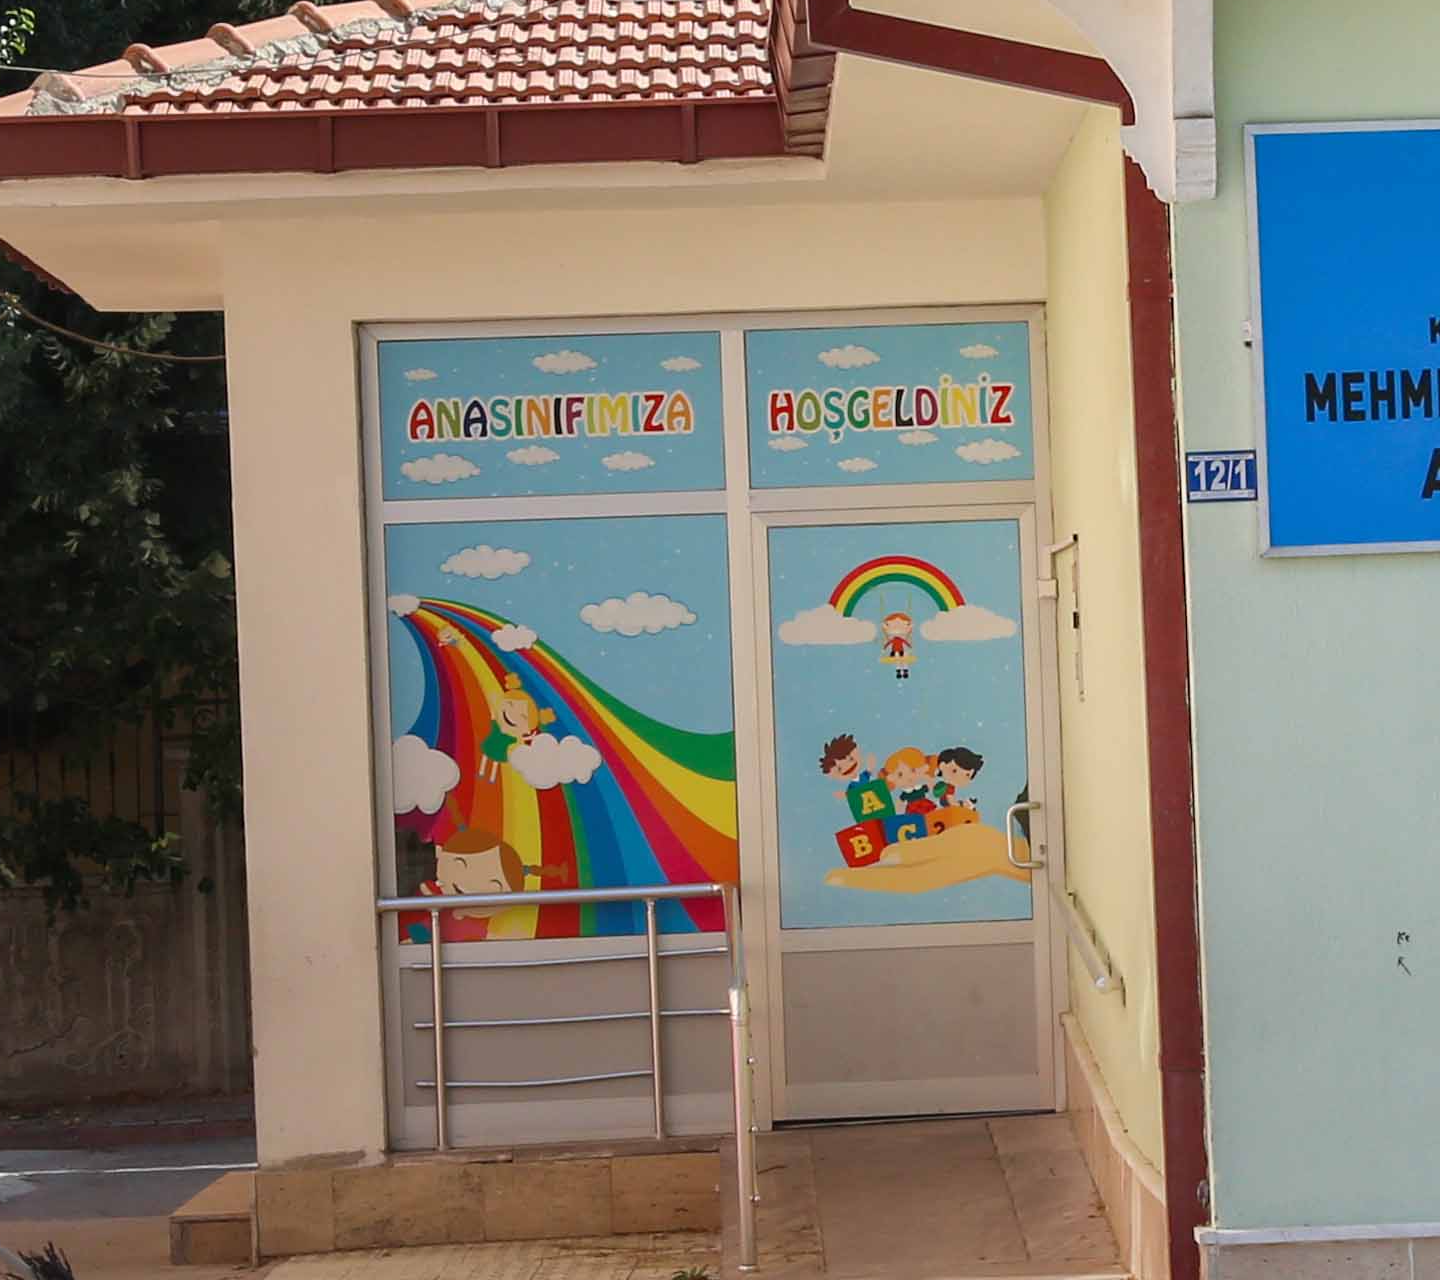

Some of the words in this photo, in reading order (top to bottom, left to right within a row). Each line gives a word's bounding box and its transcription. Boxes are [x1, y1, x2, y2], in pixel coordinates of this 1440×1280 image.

[408, 392, 692, 440] ANASINIFIMIZA
[769, 374, 1013, 444] HOŞGELDİNİZ
[1194, 460, 1247, 491] 12/1
